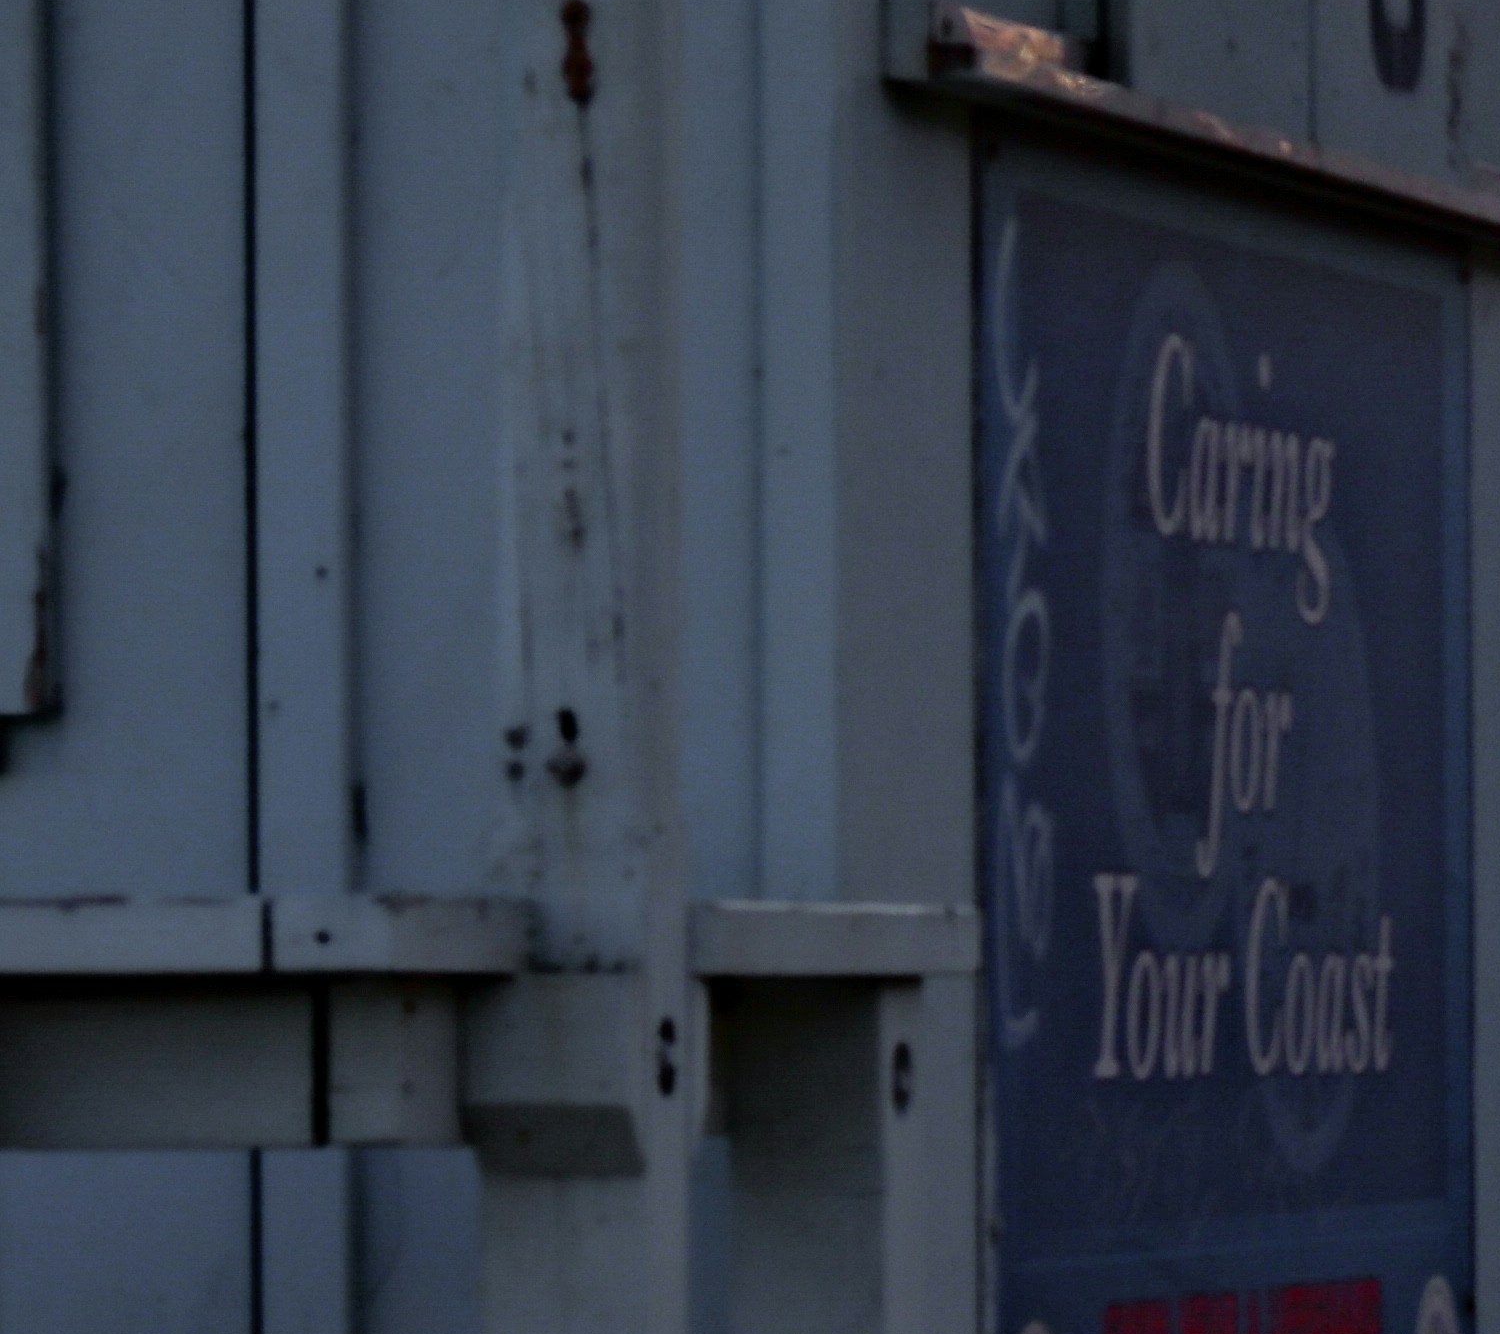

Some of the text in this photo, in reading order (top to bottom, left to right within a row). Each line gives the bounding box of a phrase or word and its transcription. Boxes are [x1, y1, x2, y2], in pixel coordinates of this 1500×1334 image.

[1145, 332, 1336, 624] Caring
[1198, 611, 1294, 878] for
[1093, 872, 1395, 1082] Your Coast
